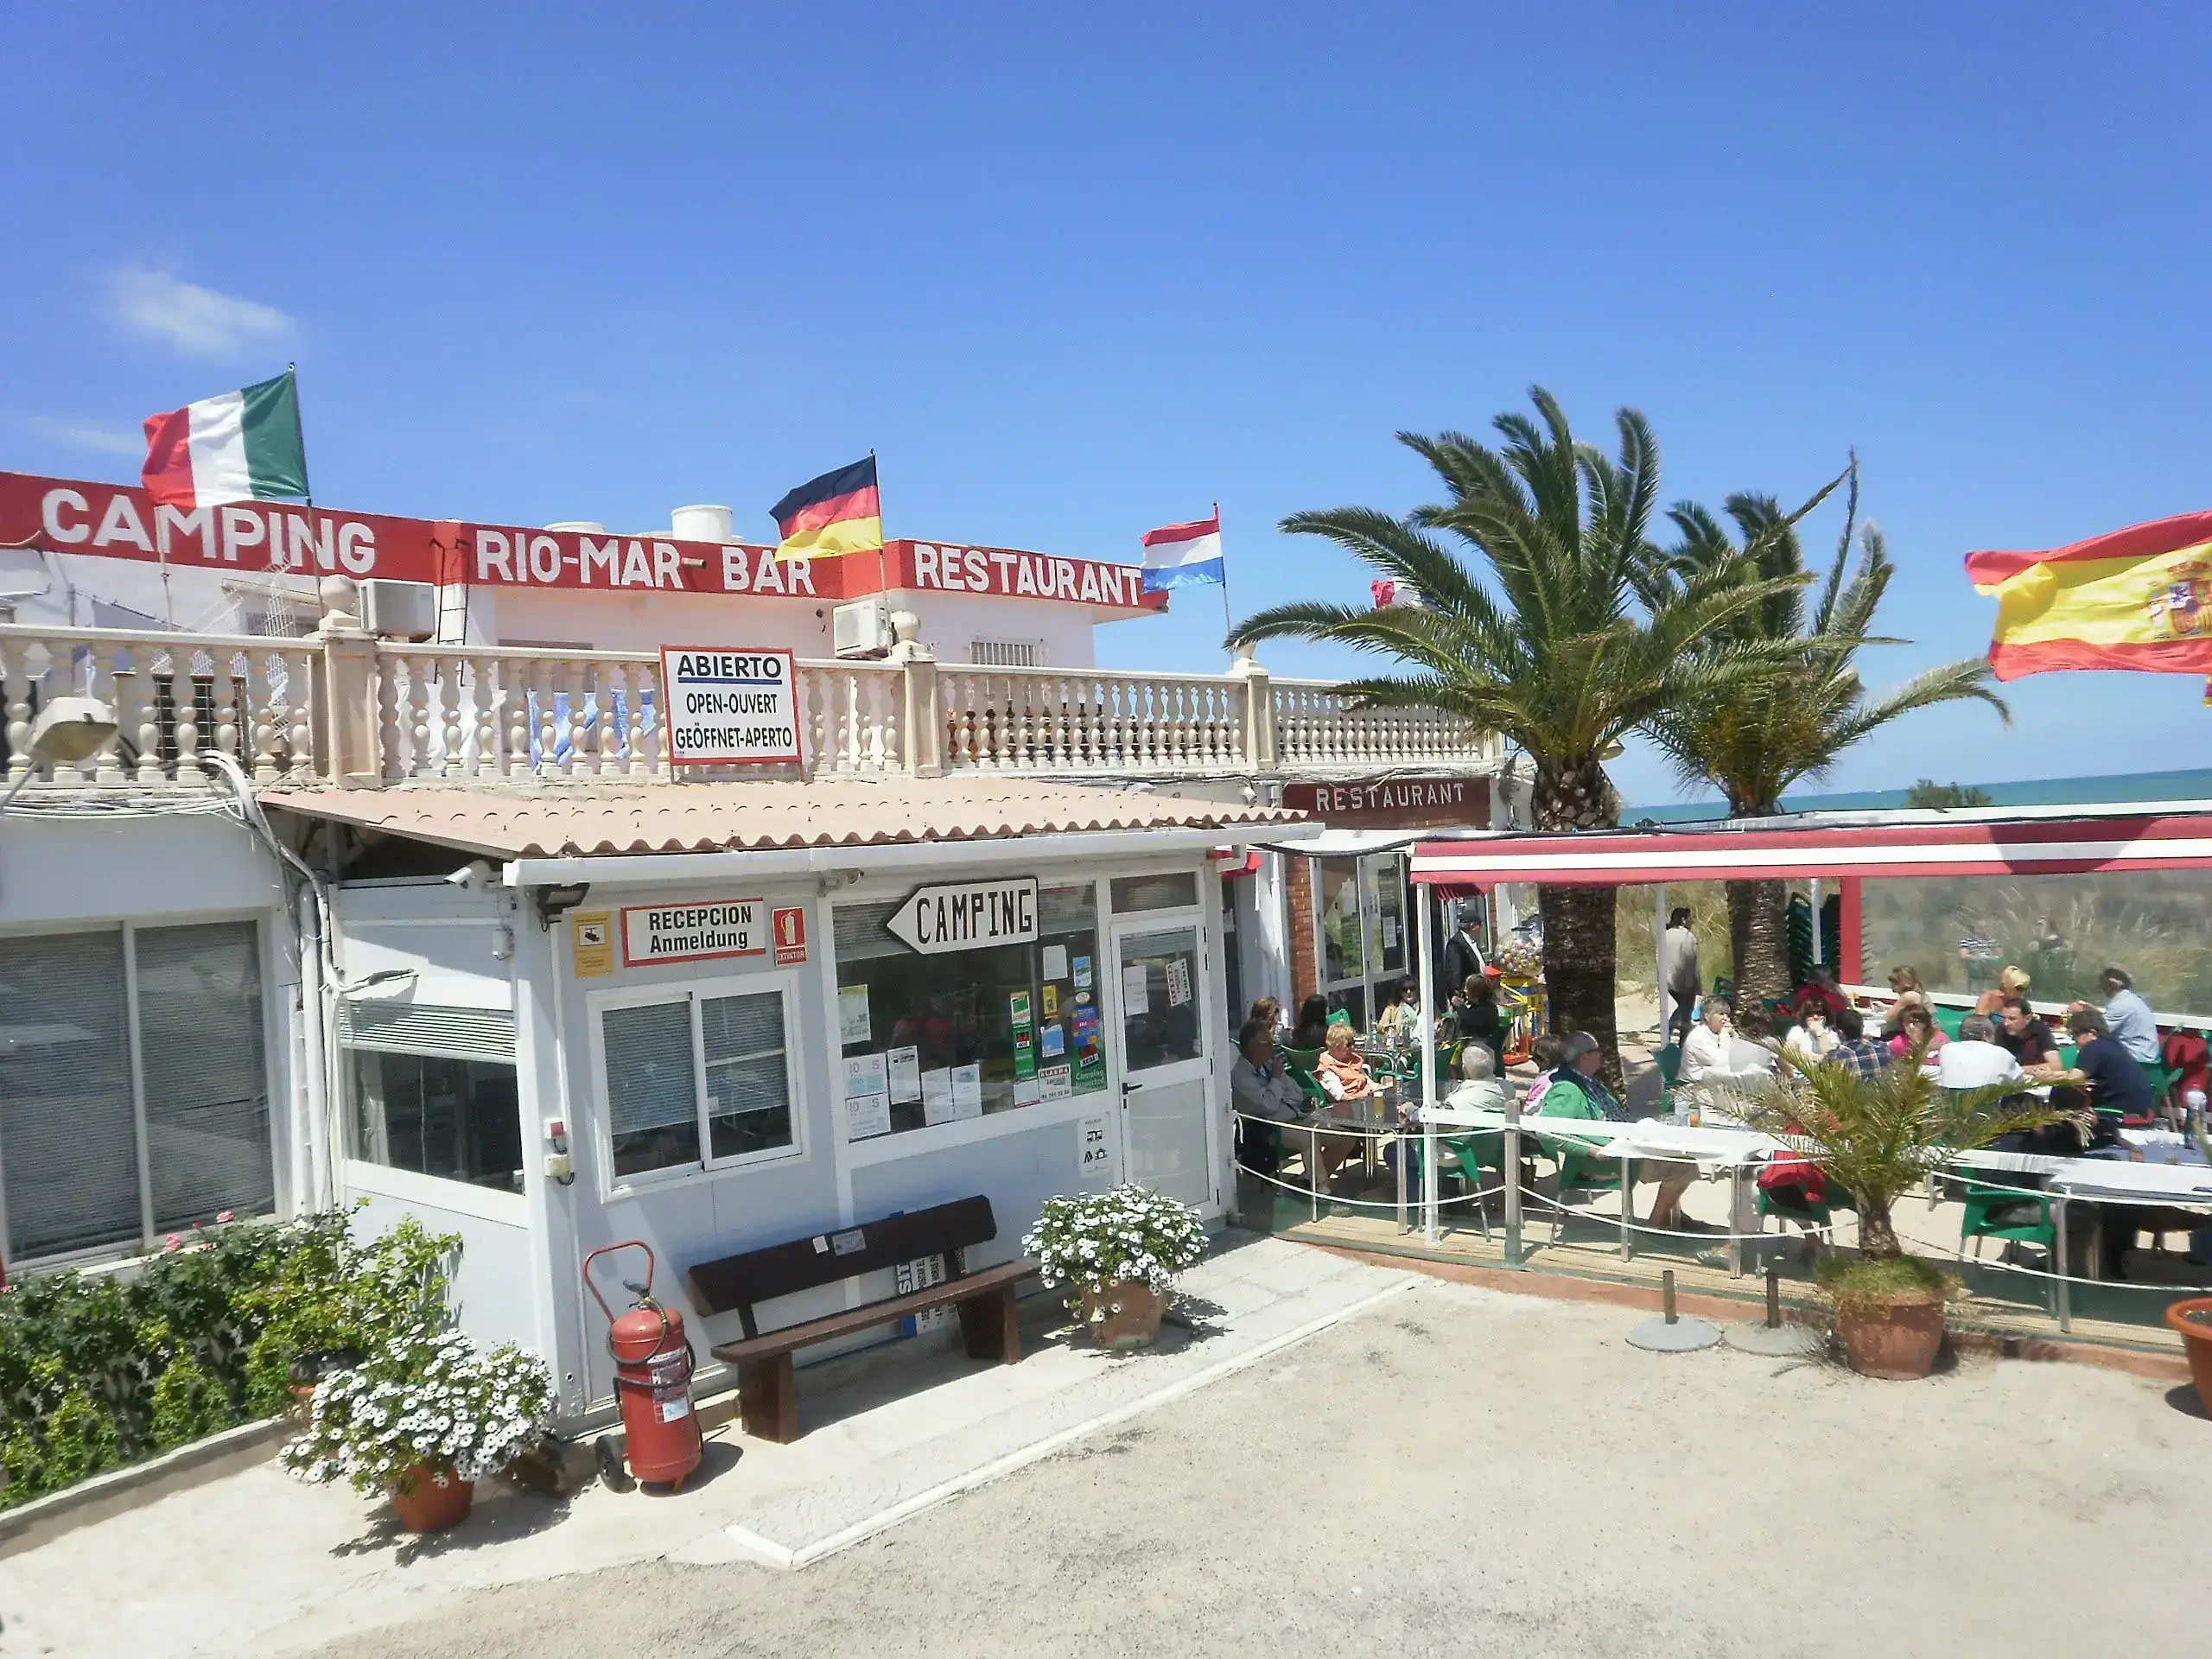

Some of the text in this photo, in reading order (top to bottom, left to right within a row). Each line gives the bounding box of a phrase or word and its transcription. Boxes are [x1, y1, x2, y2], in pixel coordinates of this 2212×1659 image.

[41, 488, 377, 574] CAMPING
[477, 531, 816, 595] RIO-MAR BAR
[914, 543, 1142, 607] RESTAURANT
[677, 654, 781, 678] ABIERTO
[686, 692, 777, 714] OPEN-OUVERT
[675, 721, 792, 749] GEÖFFNET-APERTO
[1316, 783, 1465, 811] RESTAURANT
[648, 906, 753, 931] RECEPCION
[916, 887, 1033, 944] CAMPING
[650, 931, 748, 953] Anmeldung
